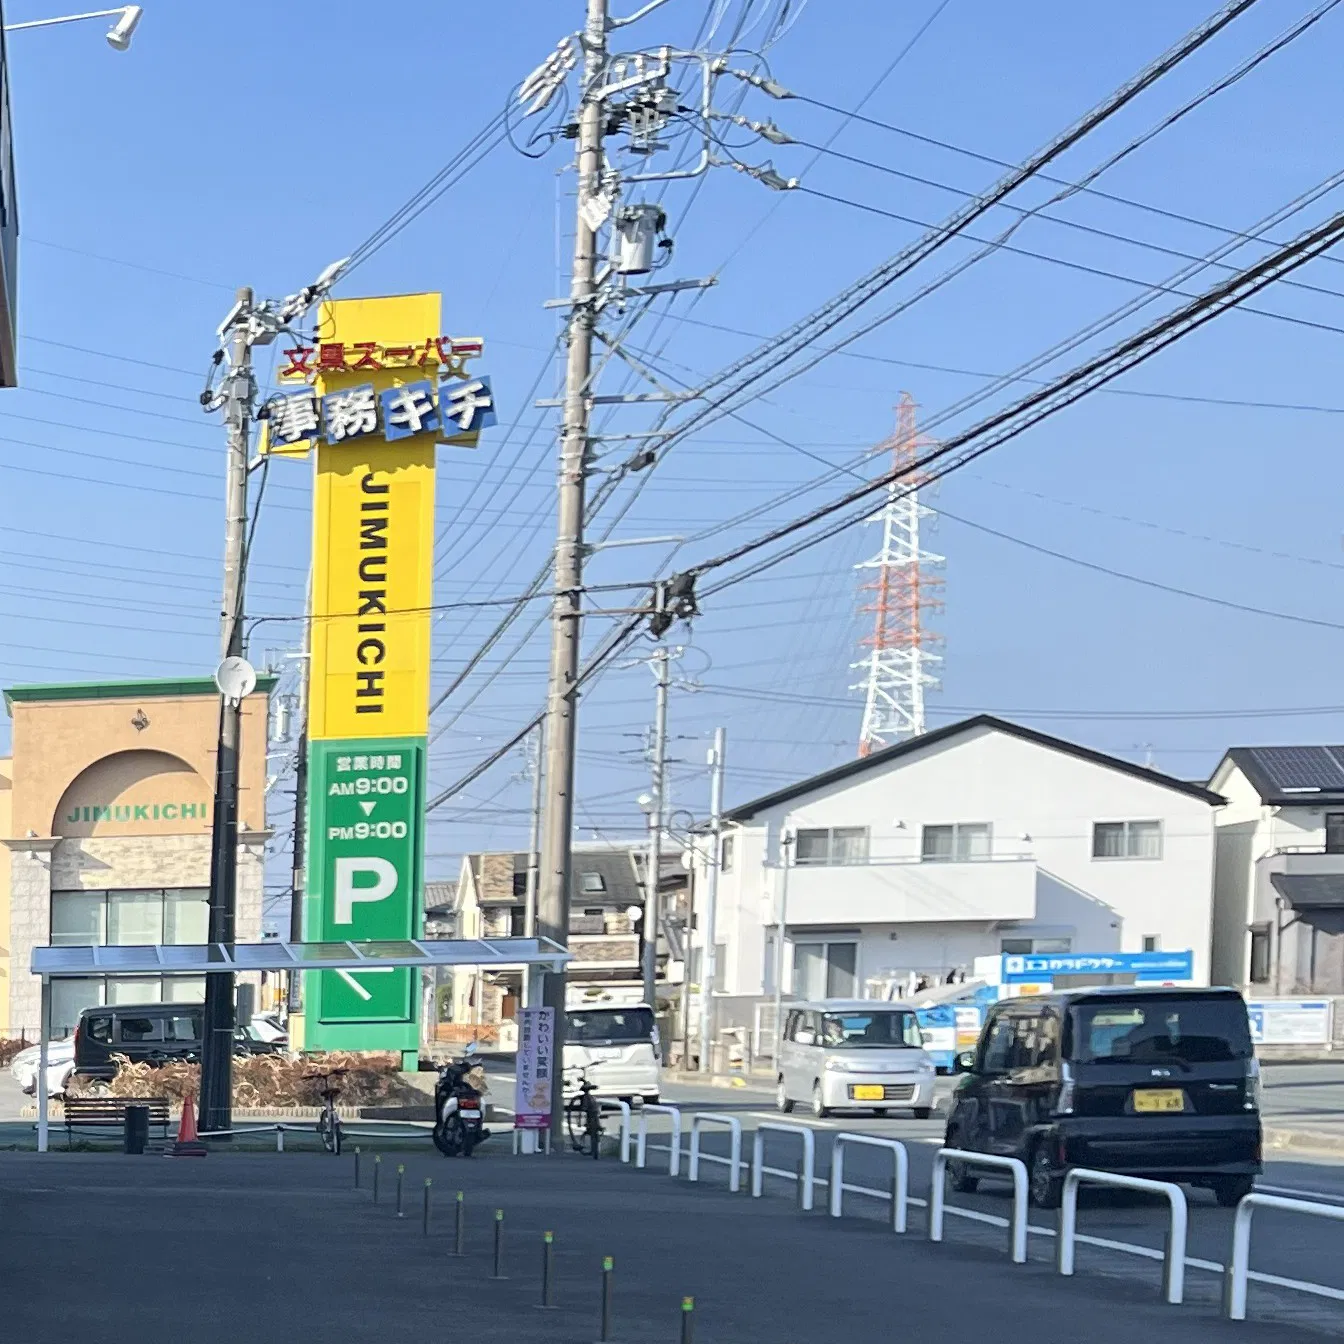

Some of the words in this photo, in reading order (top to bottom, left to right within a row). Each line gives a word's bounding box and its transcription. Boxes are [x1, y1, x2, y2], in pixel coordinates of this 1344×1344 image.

[282, 336, 483, 377] 文具スーパー
[267, 380, 492, 442] 事務キチ
[356, 473, 390, 714] JIMUKICHI
[67, 803, 207, 823] JIMUKICHI
[333, 856, 399, 925] P
